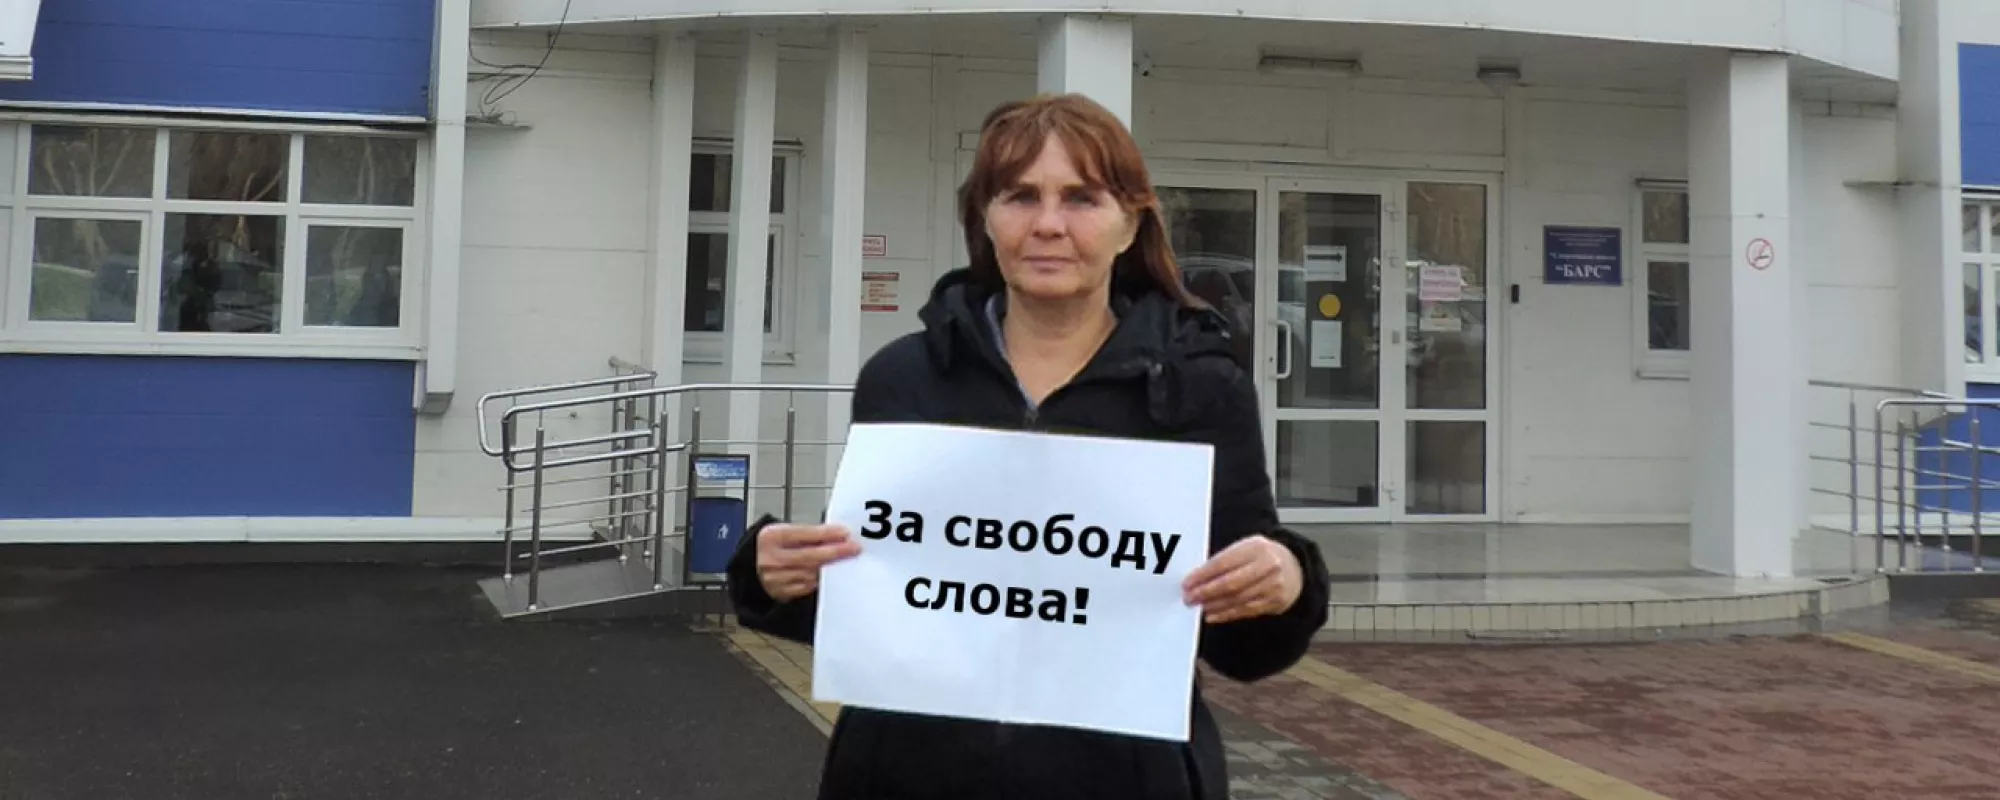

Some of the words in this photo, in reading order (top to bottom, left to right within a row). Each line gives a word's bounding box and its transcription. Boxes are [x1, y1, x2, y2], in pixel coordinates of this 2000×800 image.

[860, 500, 924, 544] За
[944, 513, 1182, 575] свободу
[904, 577, 1090, 625] слова!
